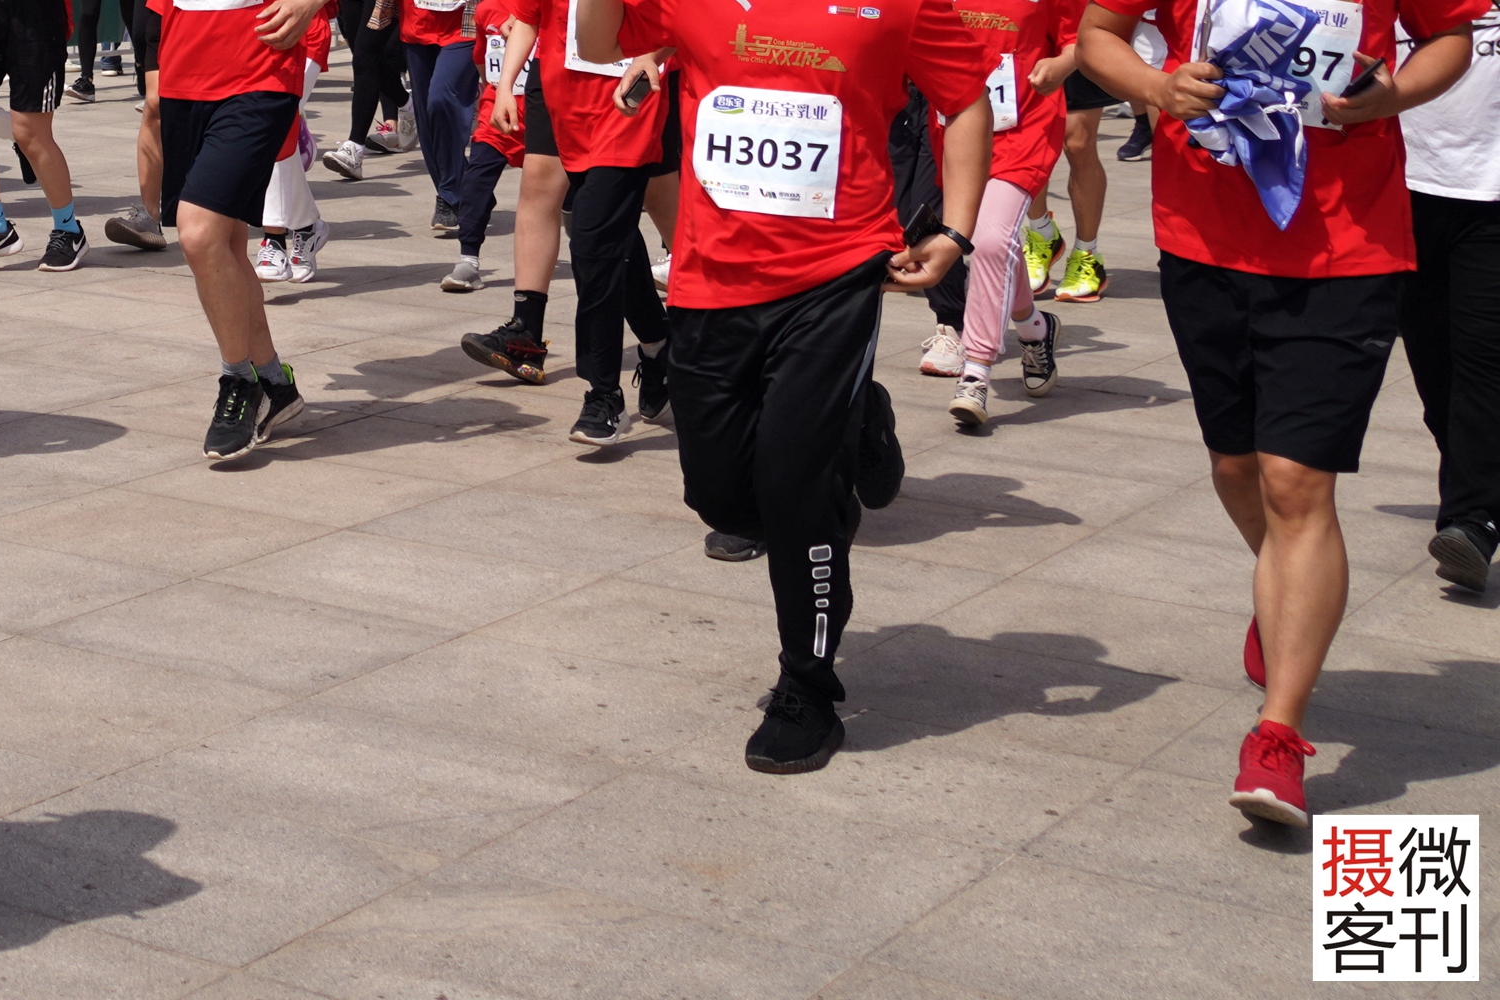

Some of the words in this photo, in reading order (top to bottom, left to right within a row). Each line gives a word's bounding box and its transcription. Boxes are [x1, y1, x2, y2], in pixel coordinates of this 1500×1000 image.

[1318, 9, 1348, 29] 乳业
[773, 38, 785, 46] One
[786, 39, 816, 48] Marathon
[750, 56, 768, 64] Cities
[1290, 46, 1345, 82] 97
[717, 96, 743, 107] 君乐宝
[750, 99, 828, 121] 君乐宝乳业
[706, 133, 829, 173] H3037
